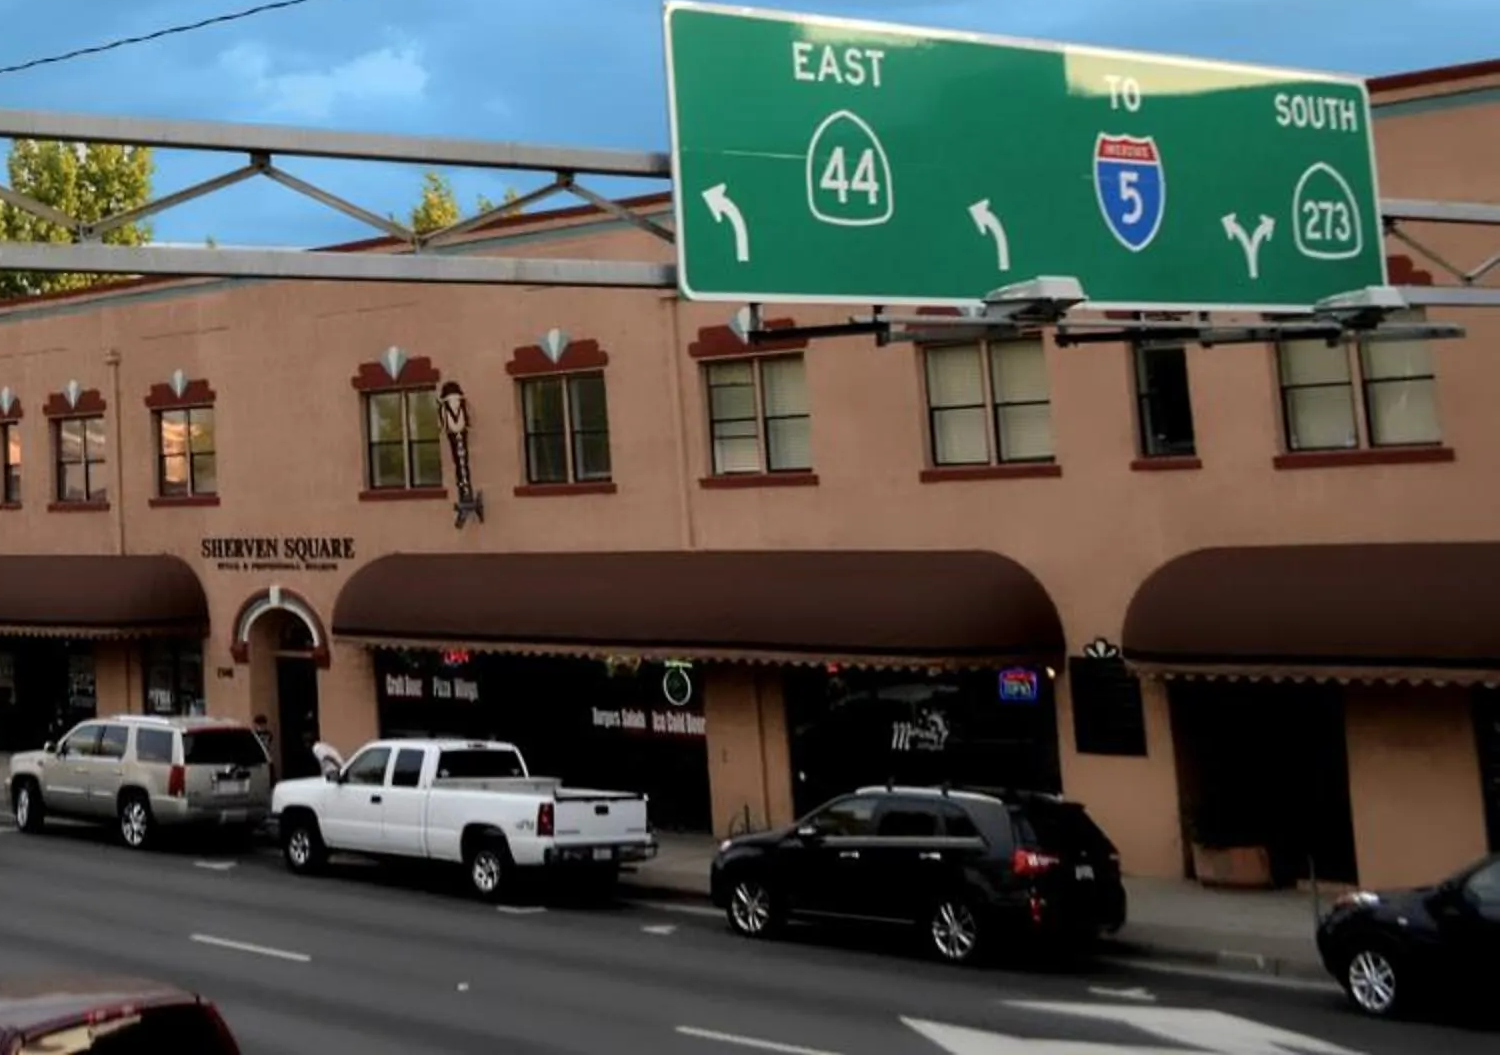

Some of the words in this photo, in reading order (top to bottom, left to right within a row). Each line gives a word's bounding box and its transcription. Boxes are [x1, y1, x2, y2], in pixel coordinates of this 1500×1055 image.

[792, 41, 885, 87] EAST
[1104, 74, 1140, 112] TO
[1275, 92, 1358, 132] SOUTH
[819, 146, 879, 205] 44
[1119, 171, 1143, 224] 5
[1301, 200, 1351, 242] 273
[201, 537, 278, 559] SHERVEN
[284, 537, 355, 561] SQUARE
